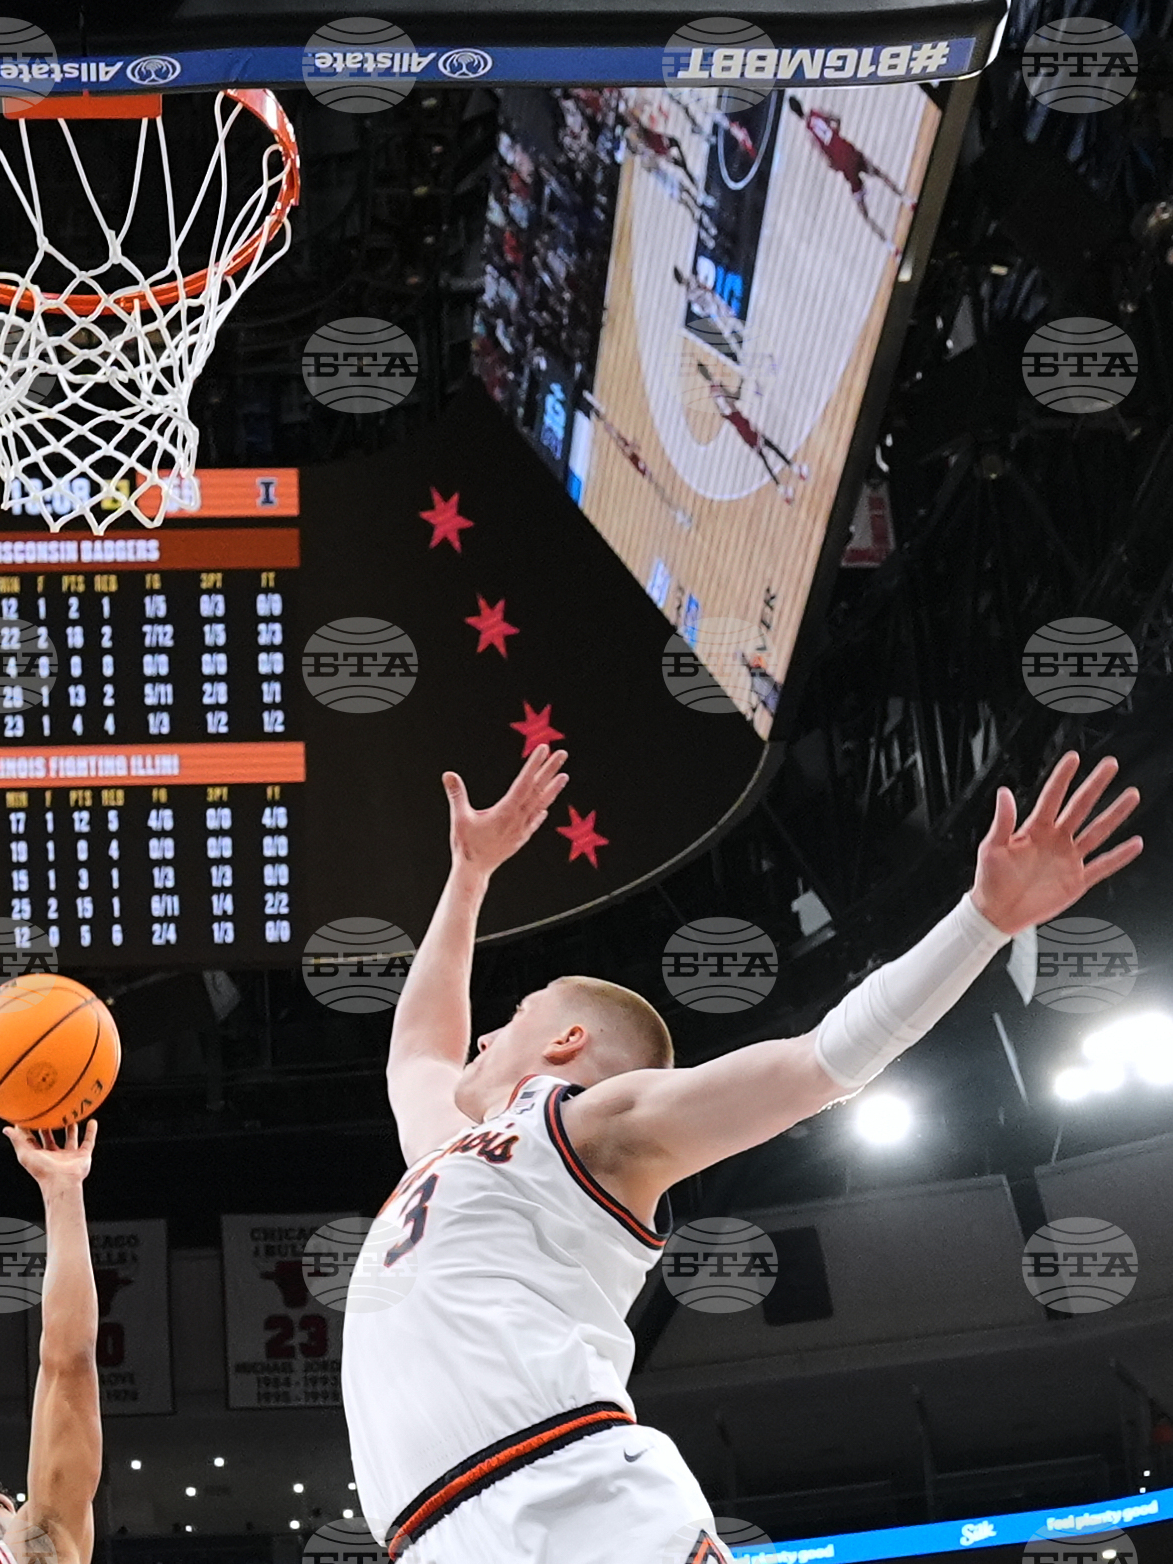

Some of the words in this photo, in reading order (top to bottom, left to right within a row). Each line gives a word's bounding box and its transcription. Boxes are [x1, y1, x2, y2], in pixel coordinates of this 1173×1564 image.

[0, 60, 123, 82] Allstate
[314, 52, 437, 73] Allstate
[678, 40, 951, 79] #B1GMBBT
[80, 539, 160, 563] BADGERS
[264, 892, 290, 915] 2/2
[383, 1173, 440, 1268] 3
[263, 1314, 328, 1360] 23
[1123, 1500, 1159, 1524] good
[960, 1521, 997, 1547] Silk
[797, 1544, 834, 1564] good
